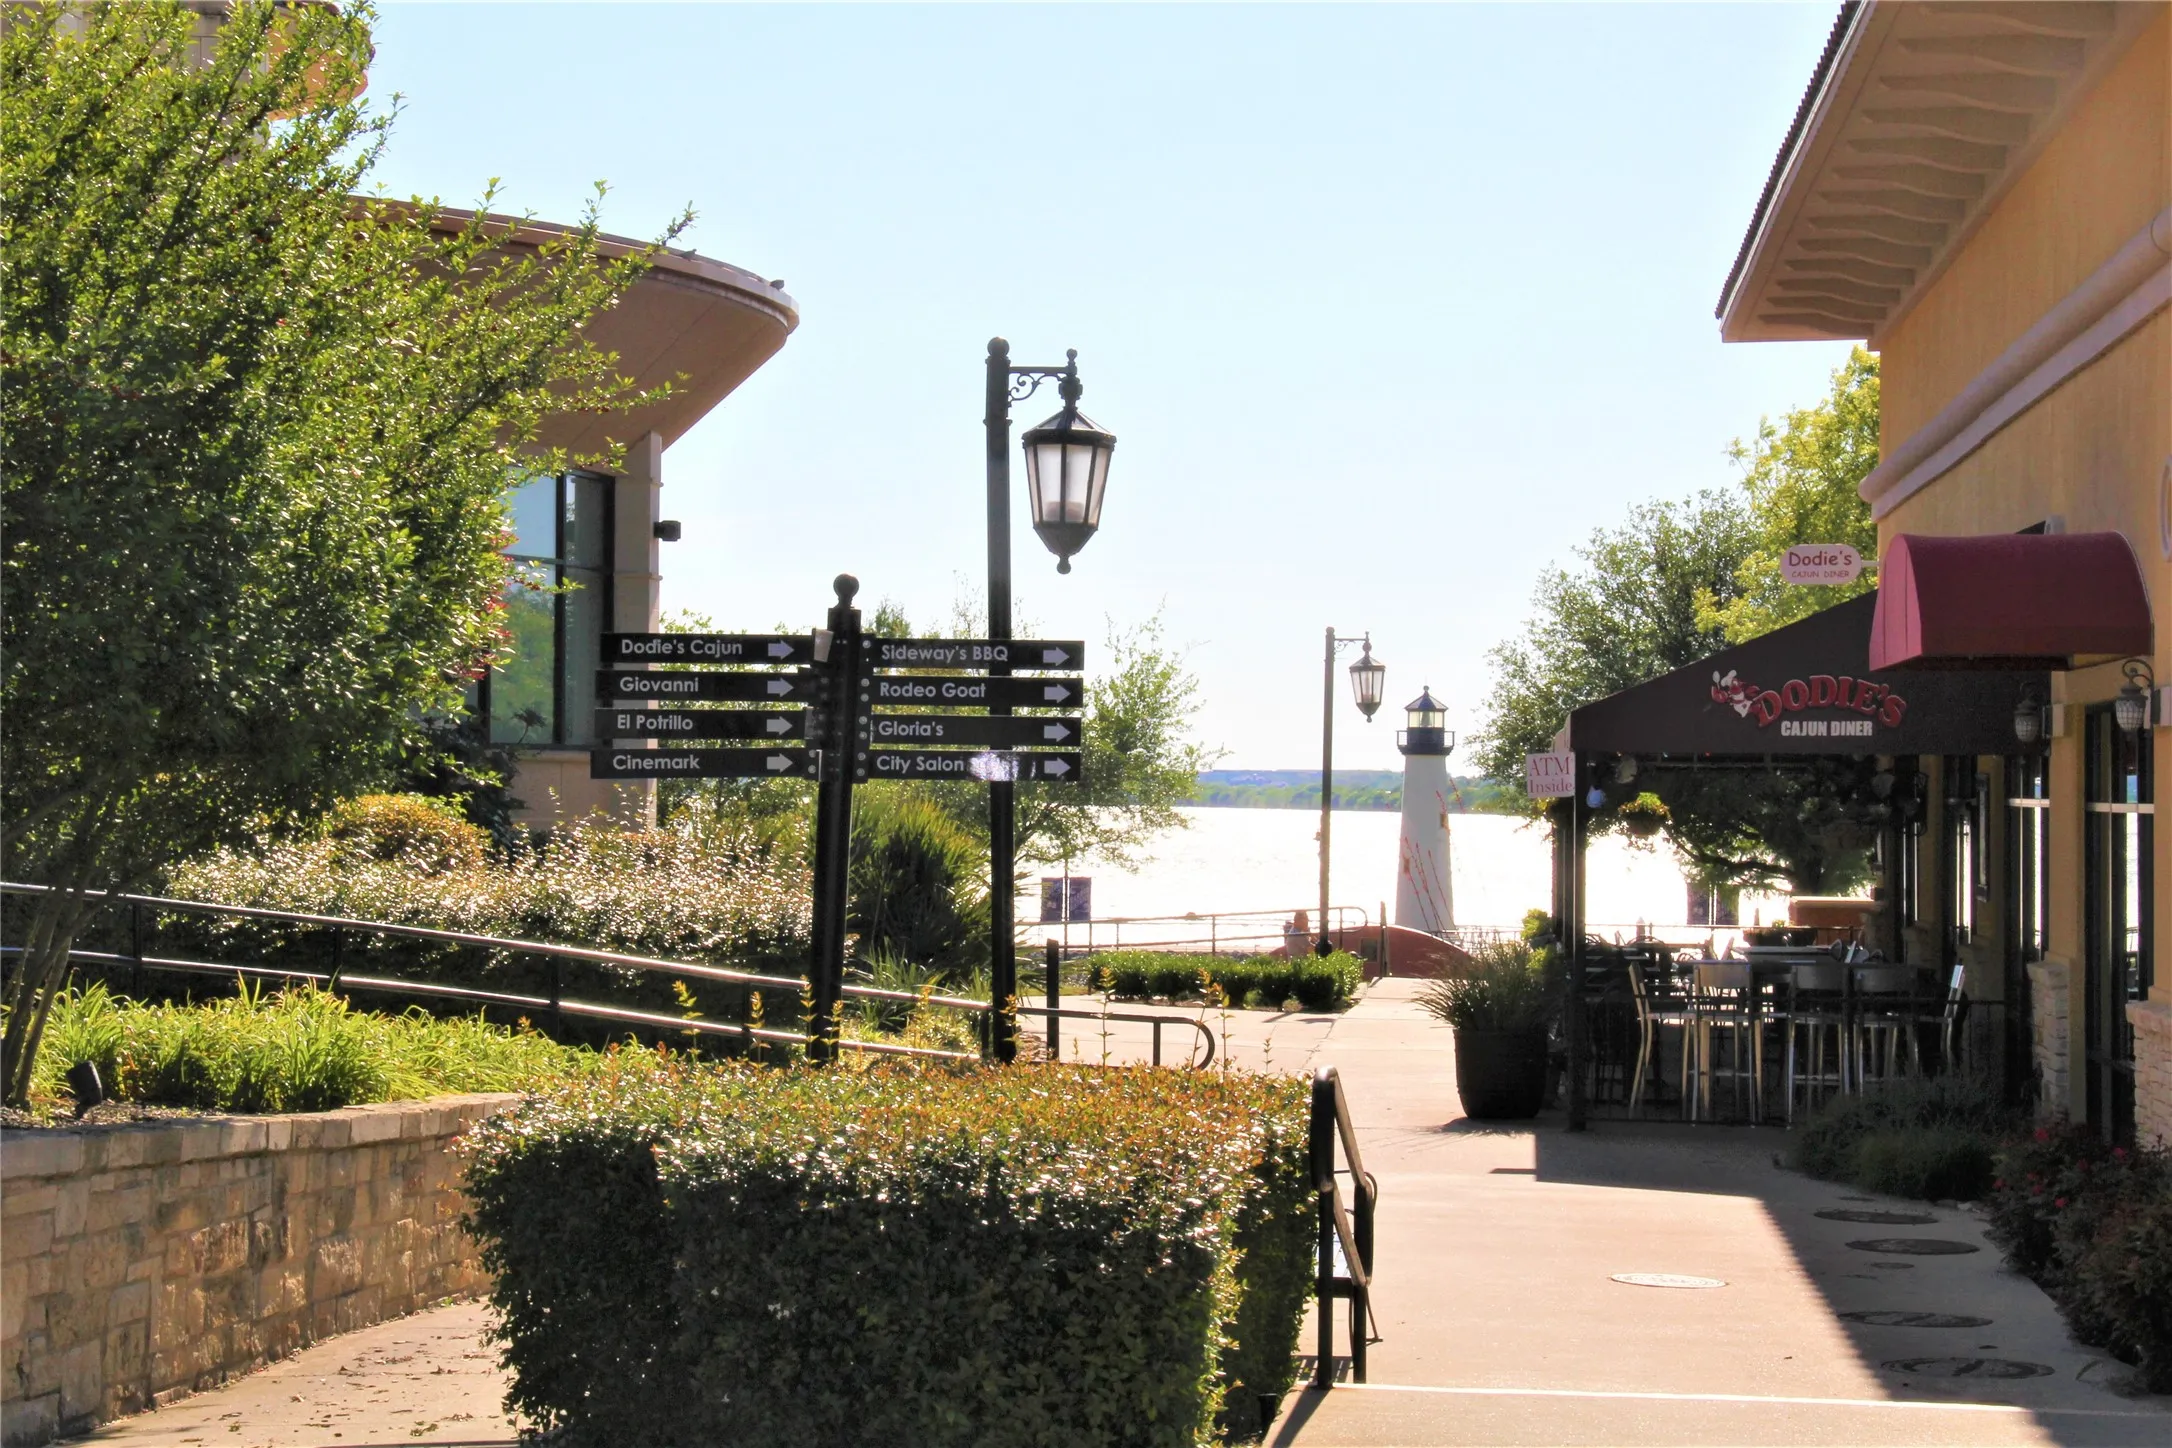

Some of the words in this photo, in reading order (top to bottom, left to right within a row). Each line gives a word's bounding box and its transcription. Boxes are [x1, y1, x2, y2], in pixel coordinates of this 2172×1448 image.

[1788, 550, 1852, 567] Dodie's
[1791, 570, 1820, 578] CAJUN
[1823, 570, 1850, 578] DINER
[621, 639, 685, 655] Dodie's
[690, 639, 742, 658] Cajun
[881, 644, 967, 664] Sideway's
[973, 646, 1009, 662] BBQ
[619, 676, 699, 693] Giovanni
[879, 681, 936, 698] Rodeo
[941, 682, 986, 698] Goat
[1751, 674, 1907, 728] DODIE'S
[617, 714, 631, 730] El
[636, 714, 693, 731] Potrillo
[878, 720, 944, 737] Gloria's
[1780, 720, 1828, 737] CAJUN
[1830, 720, 1873, 737] DINER
[612, 754, 700, 771] Cinemark
[876, 755, 911, 774] City
[916, 755, 964, 772] Salon
[1529, 756, 1571, 776] ATM
[1529, 778, 1573, 794] Inside
